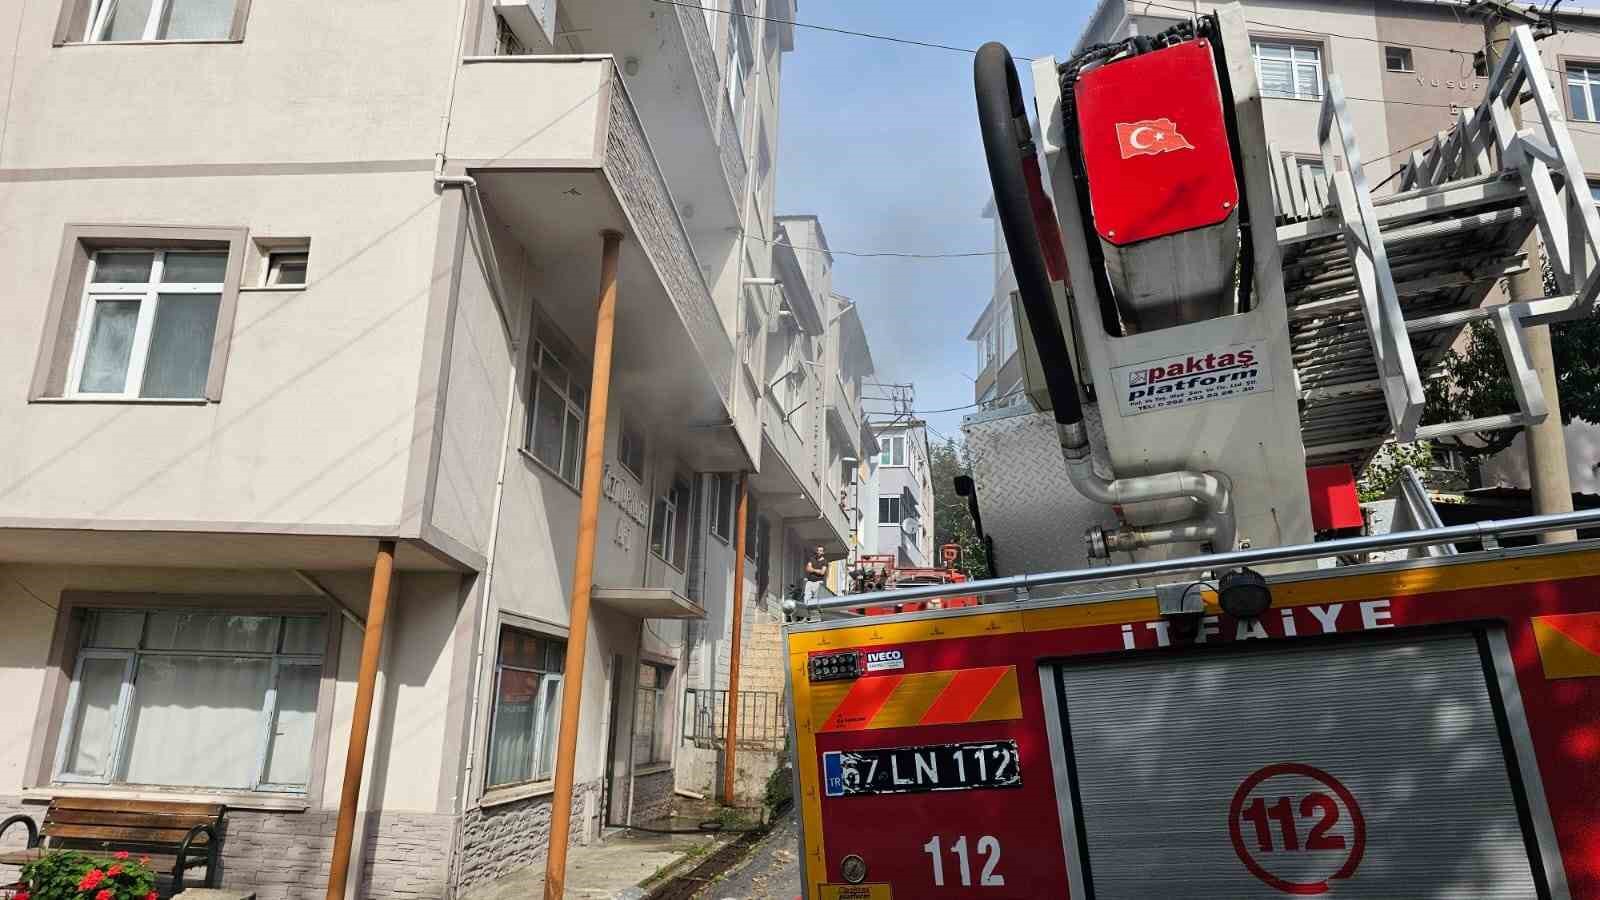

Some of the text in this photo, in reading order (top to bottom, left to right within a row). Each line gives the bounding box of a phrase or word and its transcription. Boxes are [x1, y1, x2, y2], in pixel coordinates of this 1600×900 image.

[1129, 369, 1257, 401] platform
[1148, 350, 1254, 384] paktaş
[867, 651, 901, 662] IVECO
[890, 751, 939, 786] LN
[952, 748, 1011, 786] 112
[1242, 791, 1347, 852] 112
[924, 835, 1005, 886] 112
